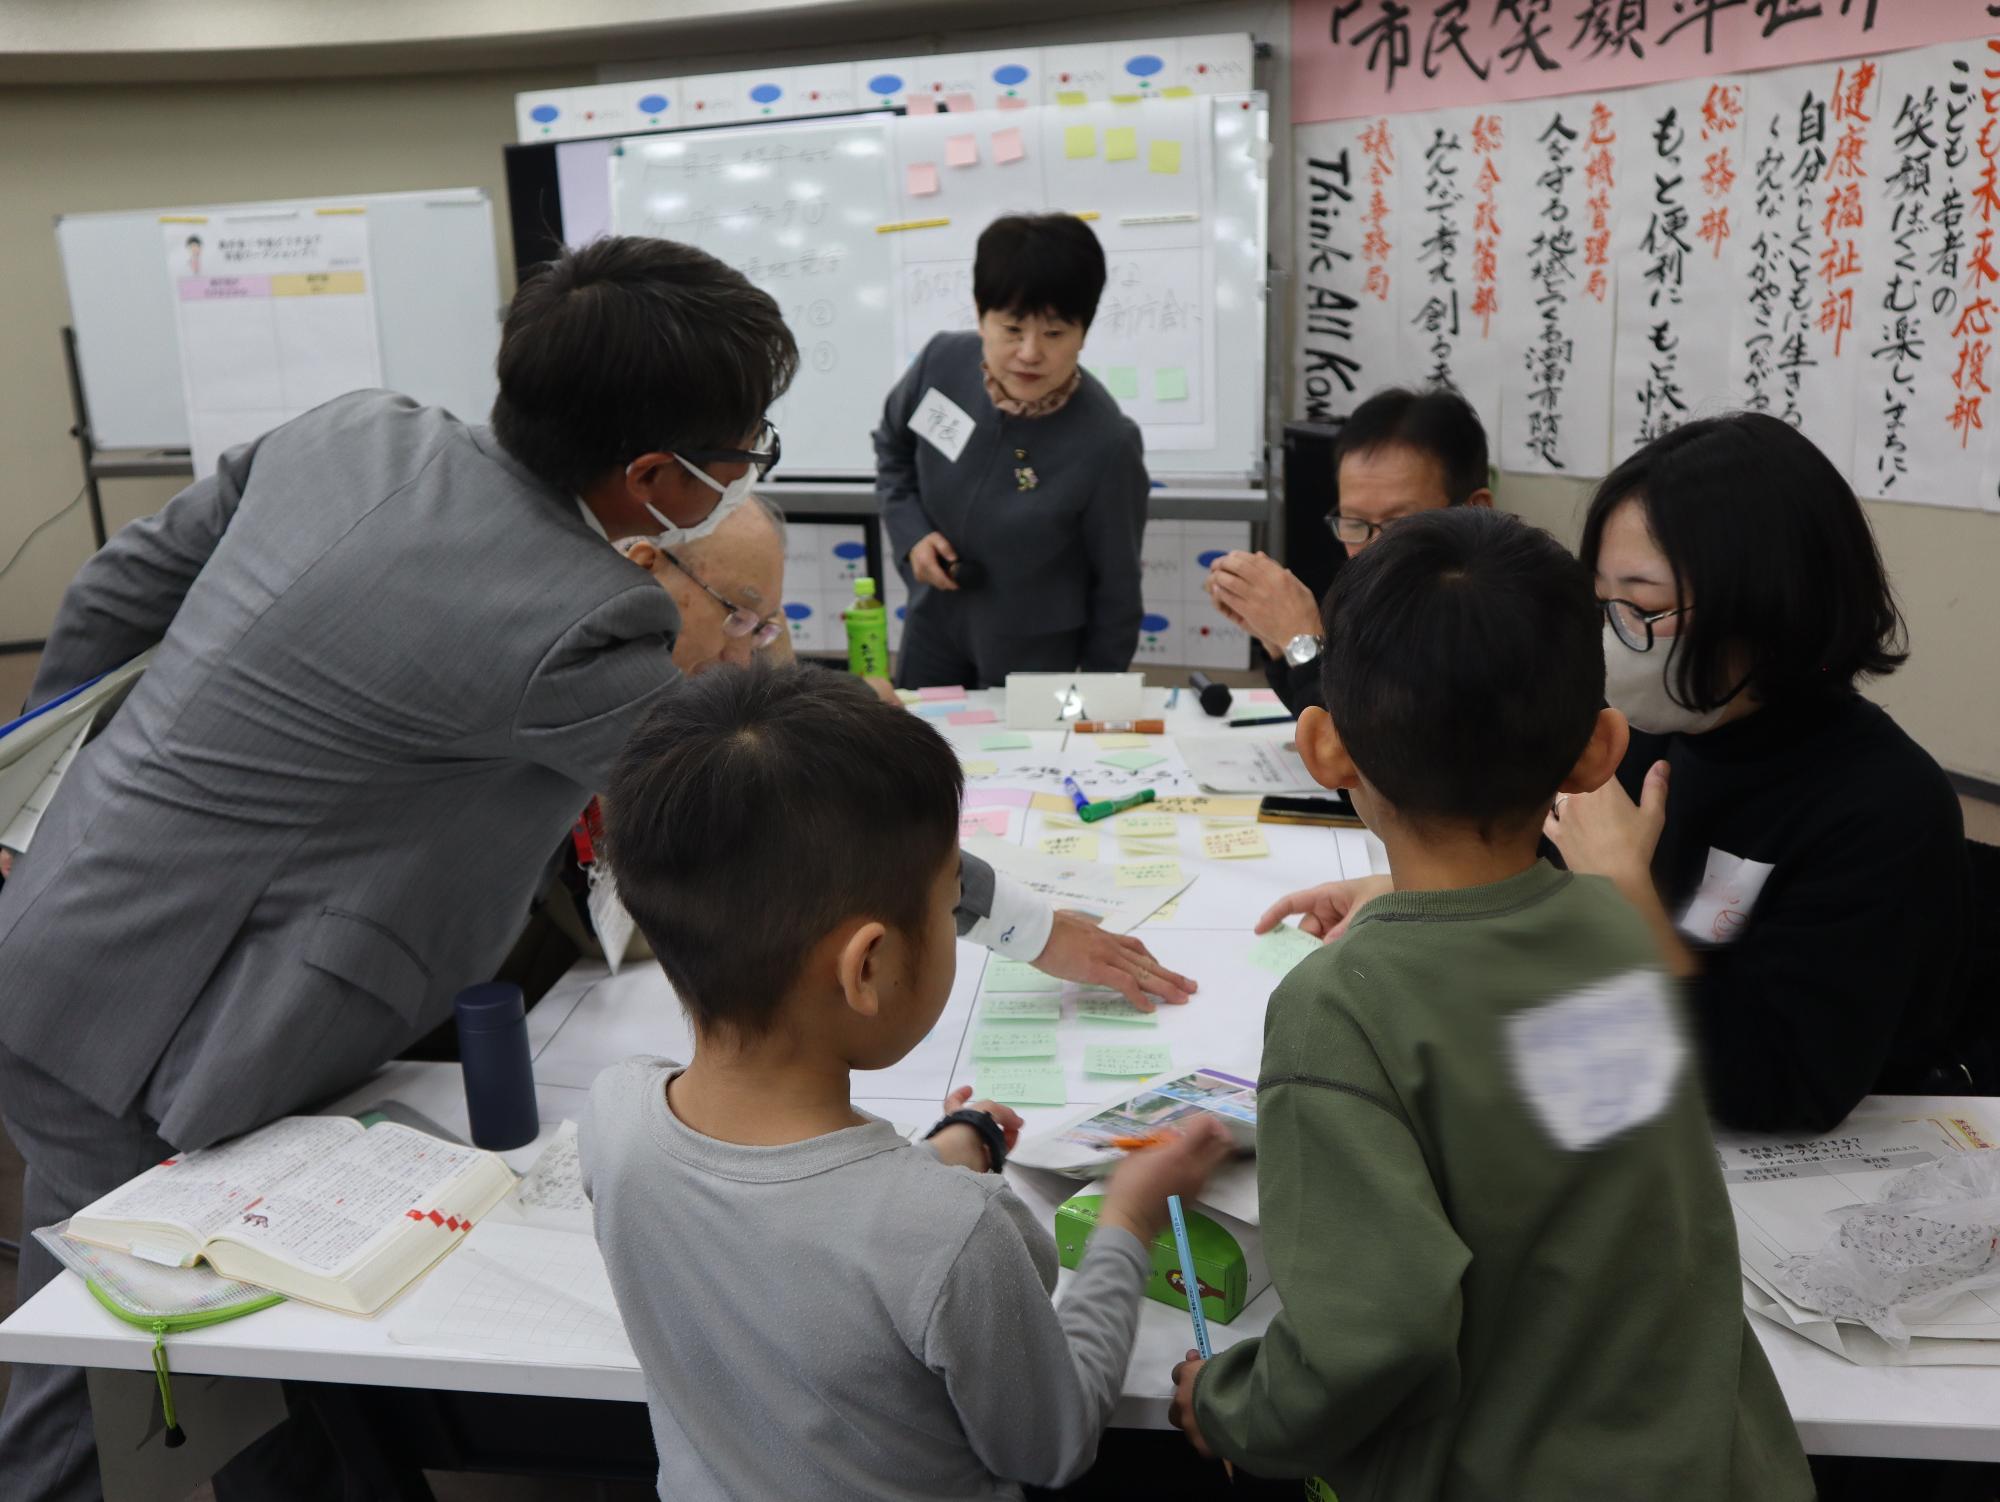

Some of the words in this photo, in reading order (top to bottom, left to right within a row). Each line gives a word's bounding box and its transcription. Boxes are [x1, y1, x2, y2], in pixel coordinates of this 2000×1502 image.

[1307, 147, 1354, 274] Think
[1584, 101, 1616, 303] 危機管理局
[1695, 84, 1743, 260] 総務部
[1814, 60, 1876, 358] 健康福祉部
[1306, 284, 1361, 341] All
[1056, 683, 1089, 721] A
